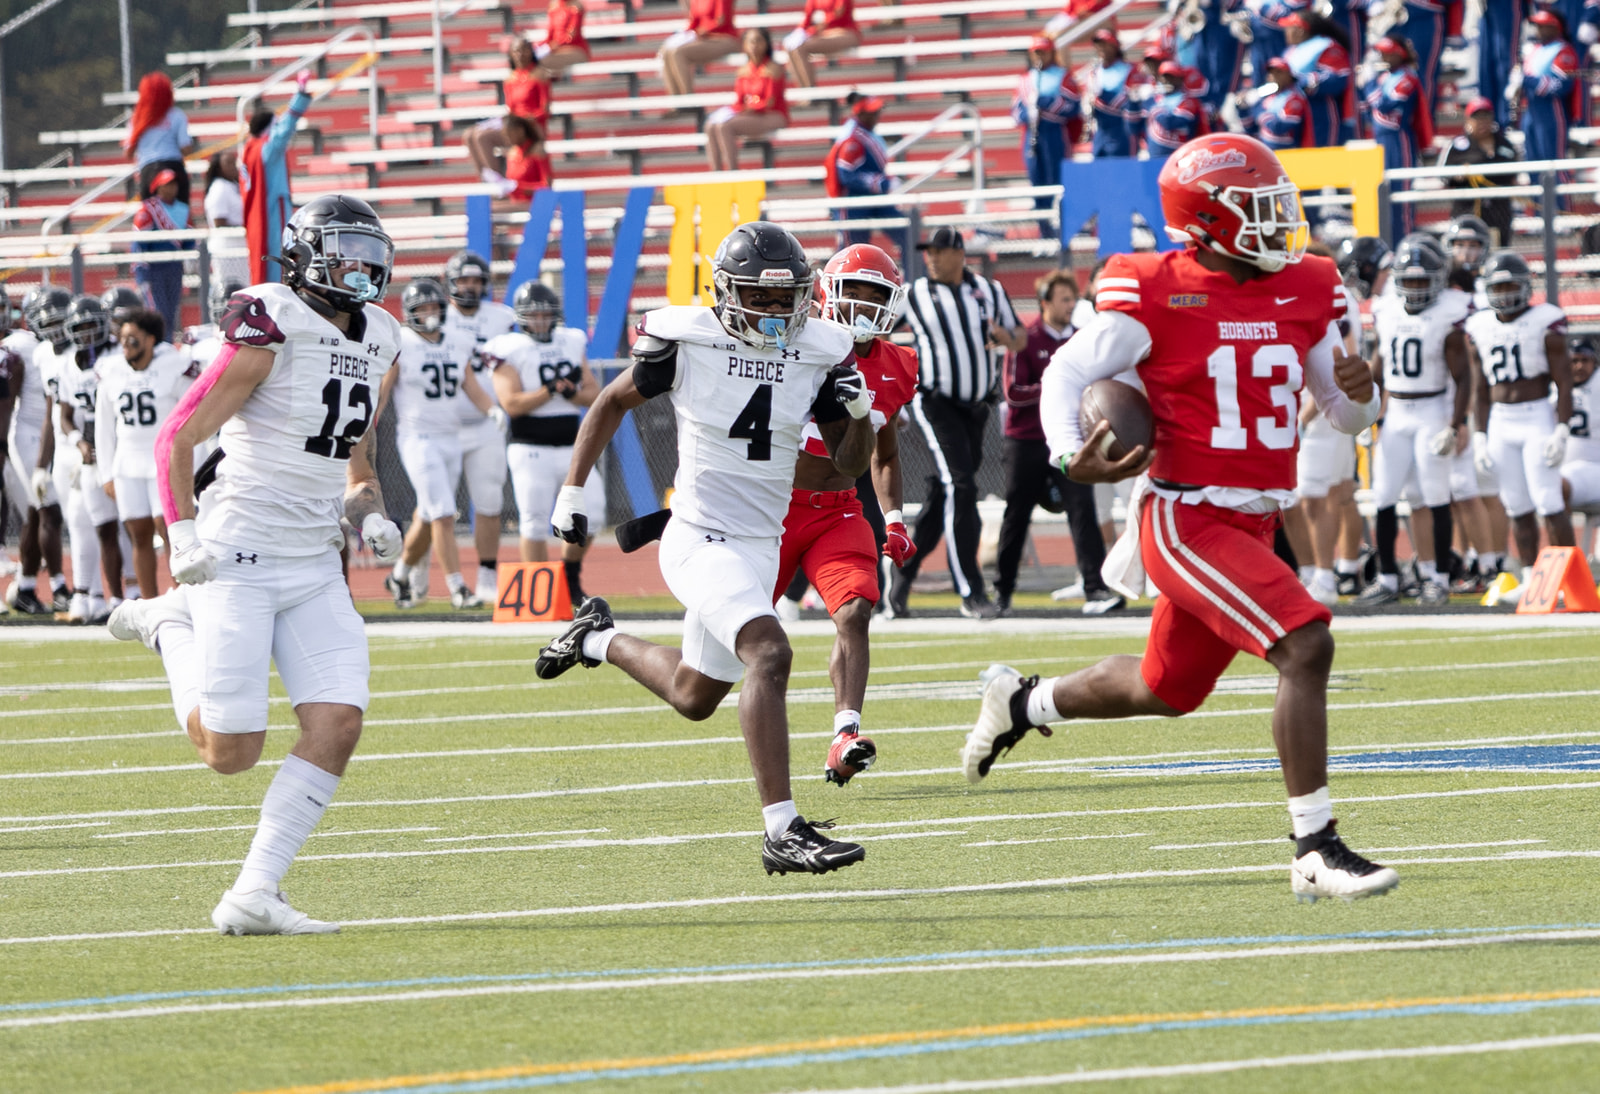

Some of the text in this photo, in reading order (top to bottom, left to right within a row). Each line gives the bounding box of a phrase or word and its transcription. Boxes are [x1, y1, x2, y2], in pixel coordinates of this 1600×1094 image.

[1218, 321, 1278, 340] HORNETS
[329, 353, 369, 381] PIERCE
[727, 356, 785, 383] PIERCE
[1391, 337, 1422, 378] 10
[1491, 344, 1523, 383] 21
[422, 363, 458, 399] 35
[1207, 344, 1303, 450] 13
[119, 391, 157, 426] 26
[304, 378, 373, 460] 12
[728, 383, 773, 461] 4
[498, 567, 554, 617] 40
